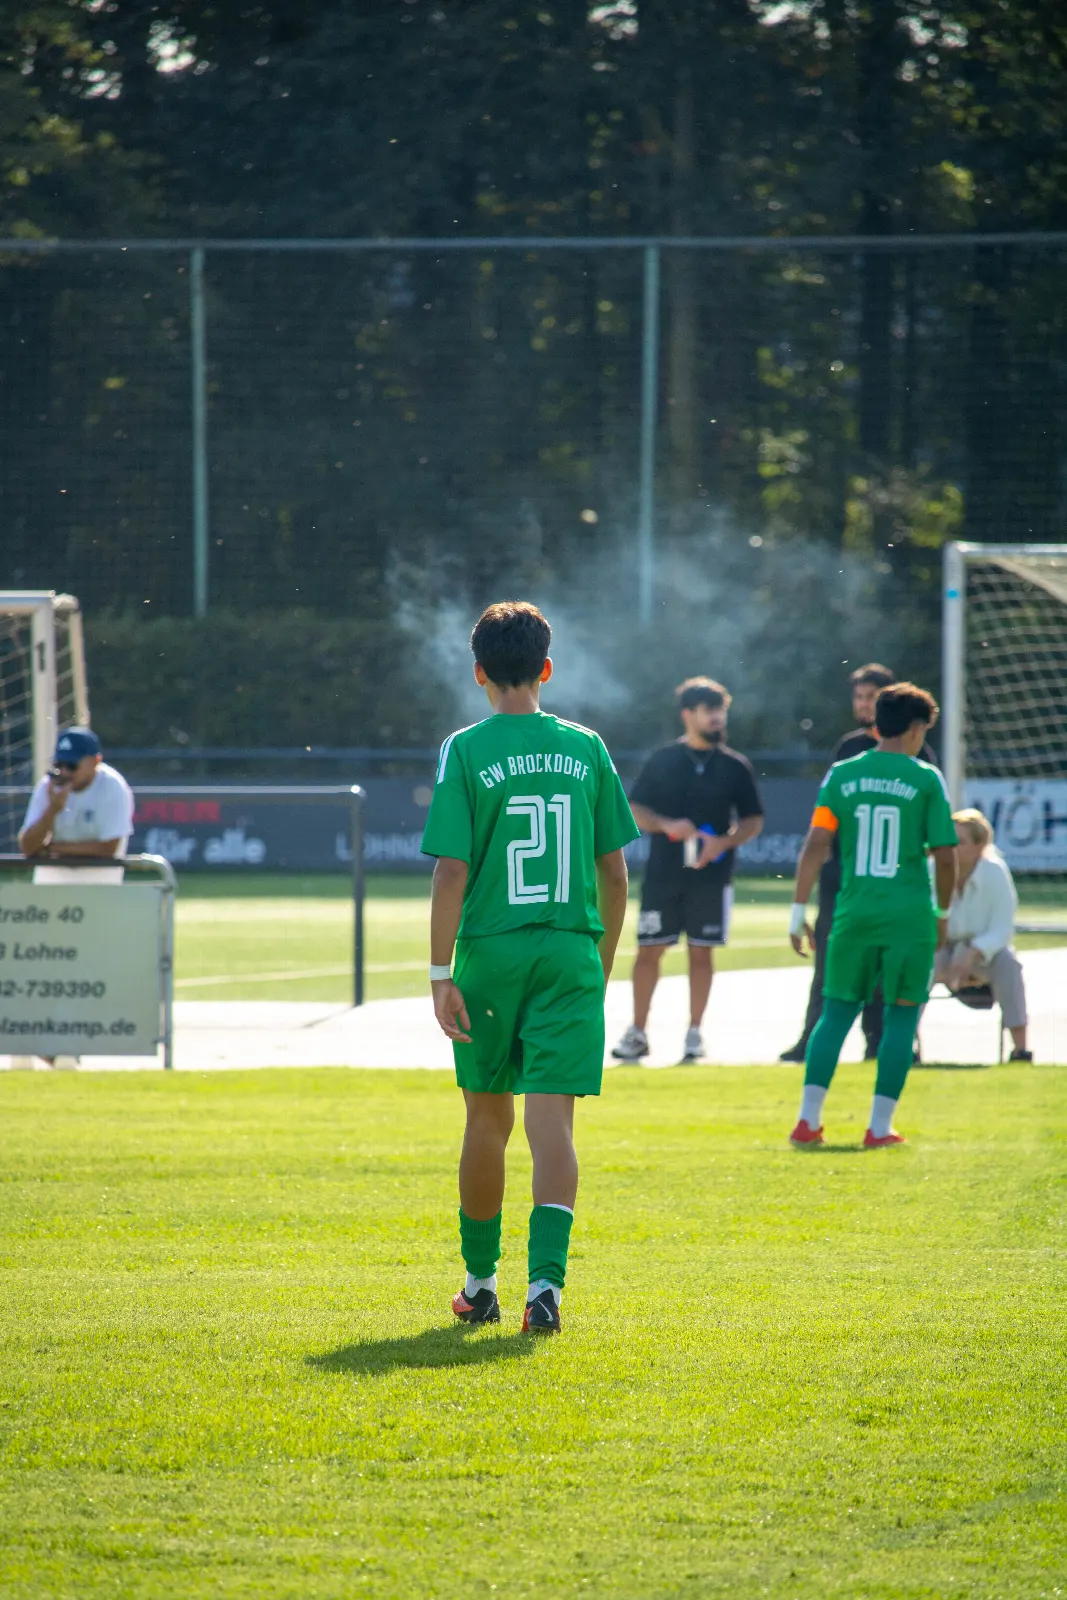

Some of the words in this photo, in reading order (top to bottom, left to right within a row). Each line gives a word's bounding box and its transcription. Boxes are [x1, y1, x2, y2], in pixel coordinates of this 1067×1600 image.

[479, 762, 506, 788] GW
[507, 753, 590, 781] BROCKDORF
[841, 781, 857, 798] GW
[145, 828, 196, 863] für
[203, 827, 267, 865] alle
[506, 794, 571, 905] 21
[854, 803, 900, 878] 10
[57, 906, 84, 923] 40
[13, 941, 78, 961] Lohne
[0, 980, 106, 999] 2-739390
